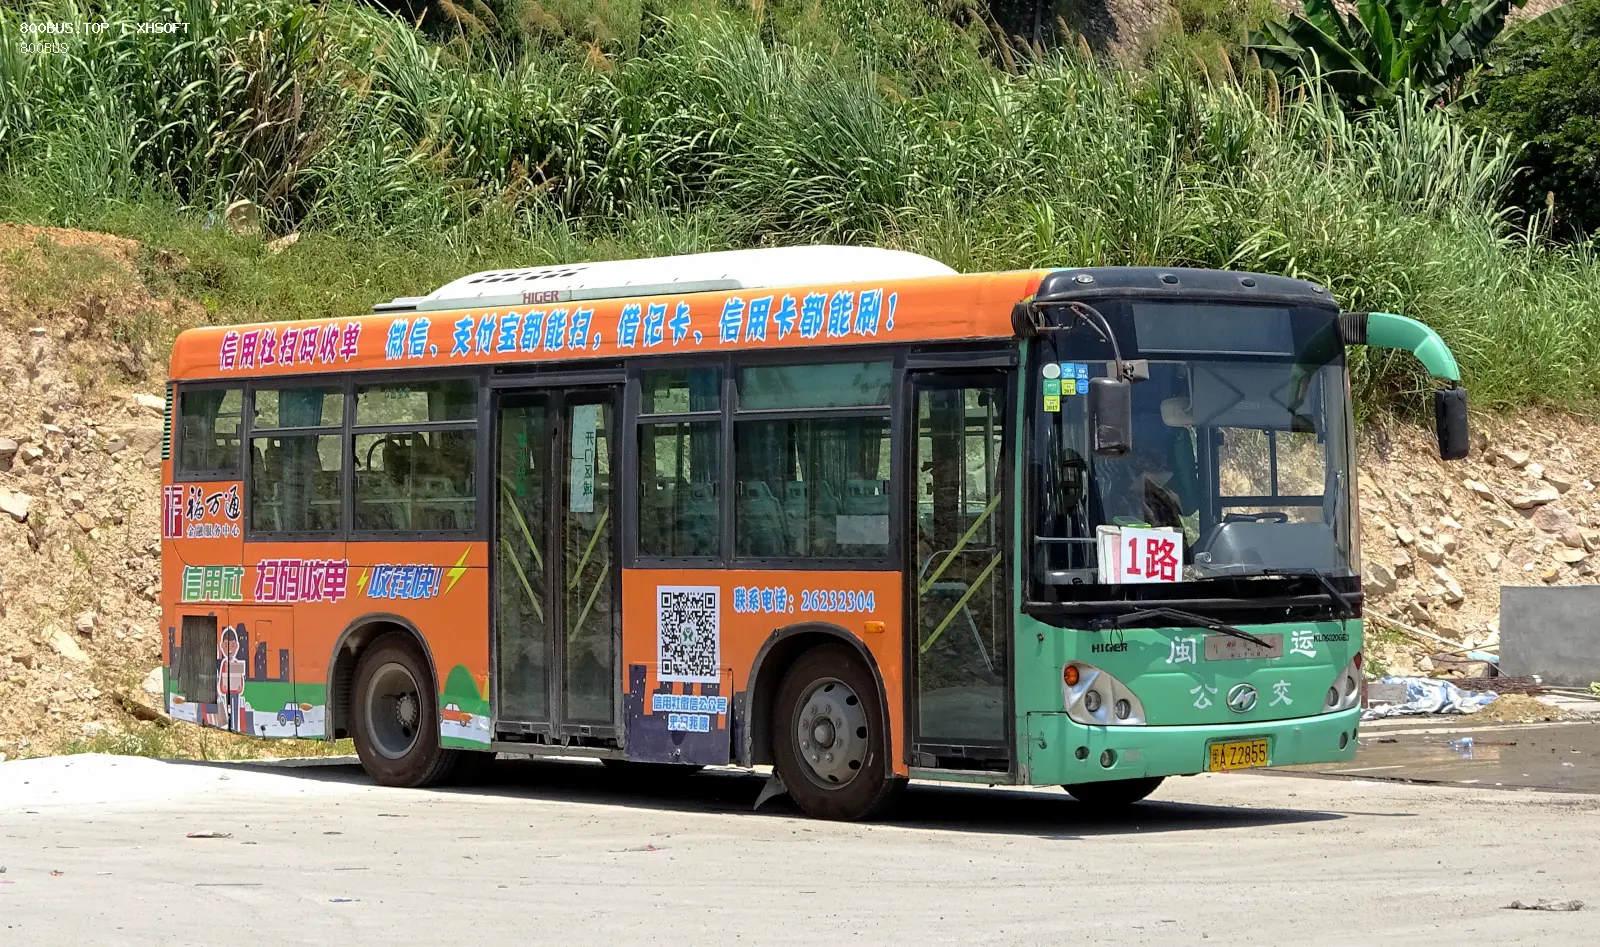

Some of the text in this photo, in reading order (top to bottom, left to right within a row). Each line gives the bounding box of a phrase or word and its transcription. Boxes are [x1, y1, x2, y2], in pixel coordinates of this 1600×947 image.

[523, 291, 559, 304] HIGER
[219, 321, 362, 371] 信用社扫码收单
[185, 484, 241, 521] 福万通
[187, 523, 240, 538] 金融服务中心
[1126, 537, 1179, 582] 1路
[182, 565, 244, 602] 信用社
[254, 559, 349, 603] 扫码收单
[801, 589, 876, 613] 26232304
[1092, 643, 1128, 653] HIGER
[1165, 636, 1197, 665] 闽
[1289, 630, 1317, 659] 运
[653, 694, 727, 714] 信用社微信公众号
[1190, 680, 1294, 709] 公 交
